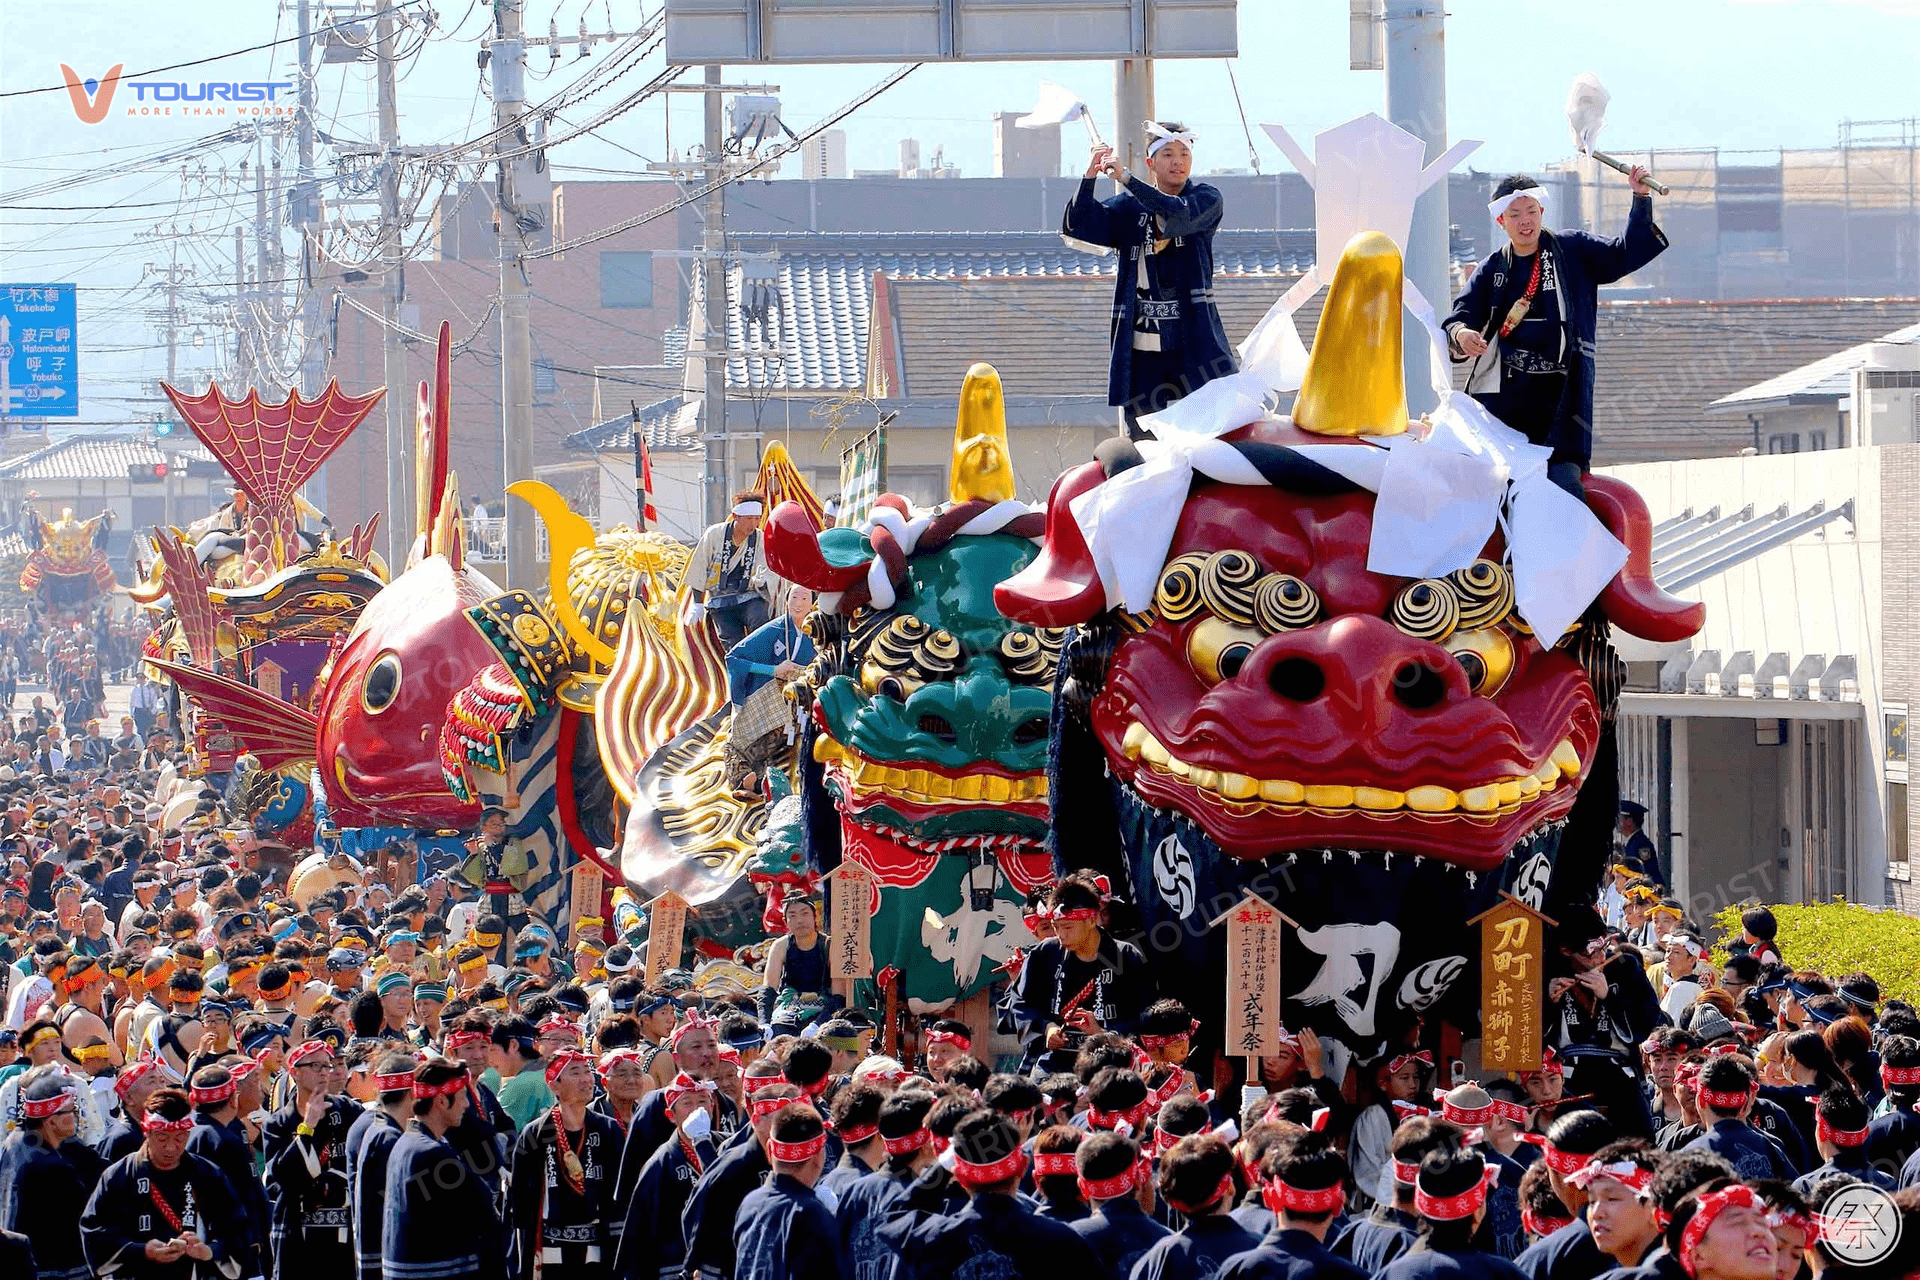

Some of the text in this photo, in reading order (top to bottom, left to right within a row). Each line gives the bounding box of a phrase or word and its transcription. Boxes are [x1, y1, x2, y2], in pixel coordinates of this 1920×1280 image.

[22, 328, 70, 342] 波戸岬
[22, 344, 70, 353] Hatomisaki
[32, 373, 63, 382] Yobuko
[842, 932, 859, 975] 式年祭
[1240, 926, 1252, 991] 千二百六十年
[1491, 917, 1533, 980] 刀町
[1287, 921, 1401, 1036] 刀
[1240, 993, 1264, 1051] 式年祭
